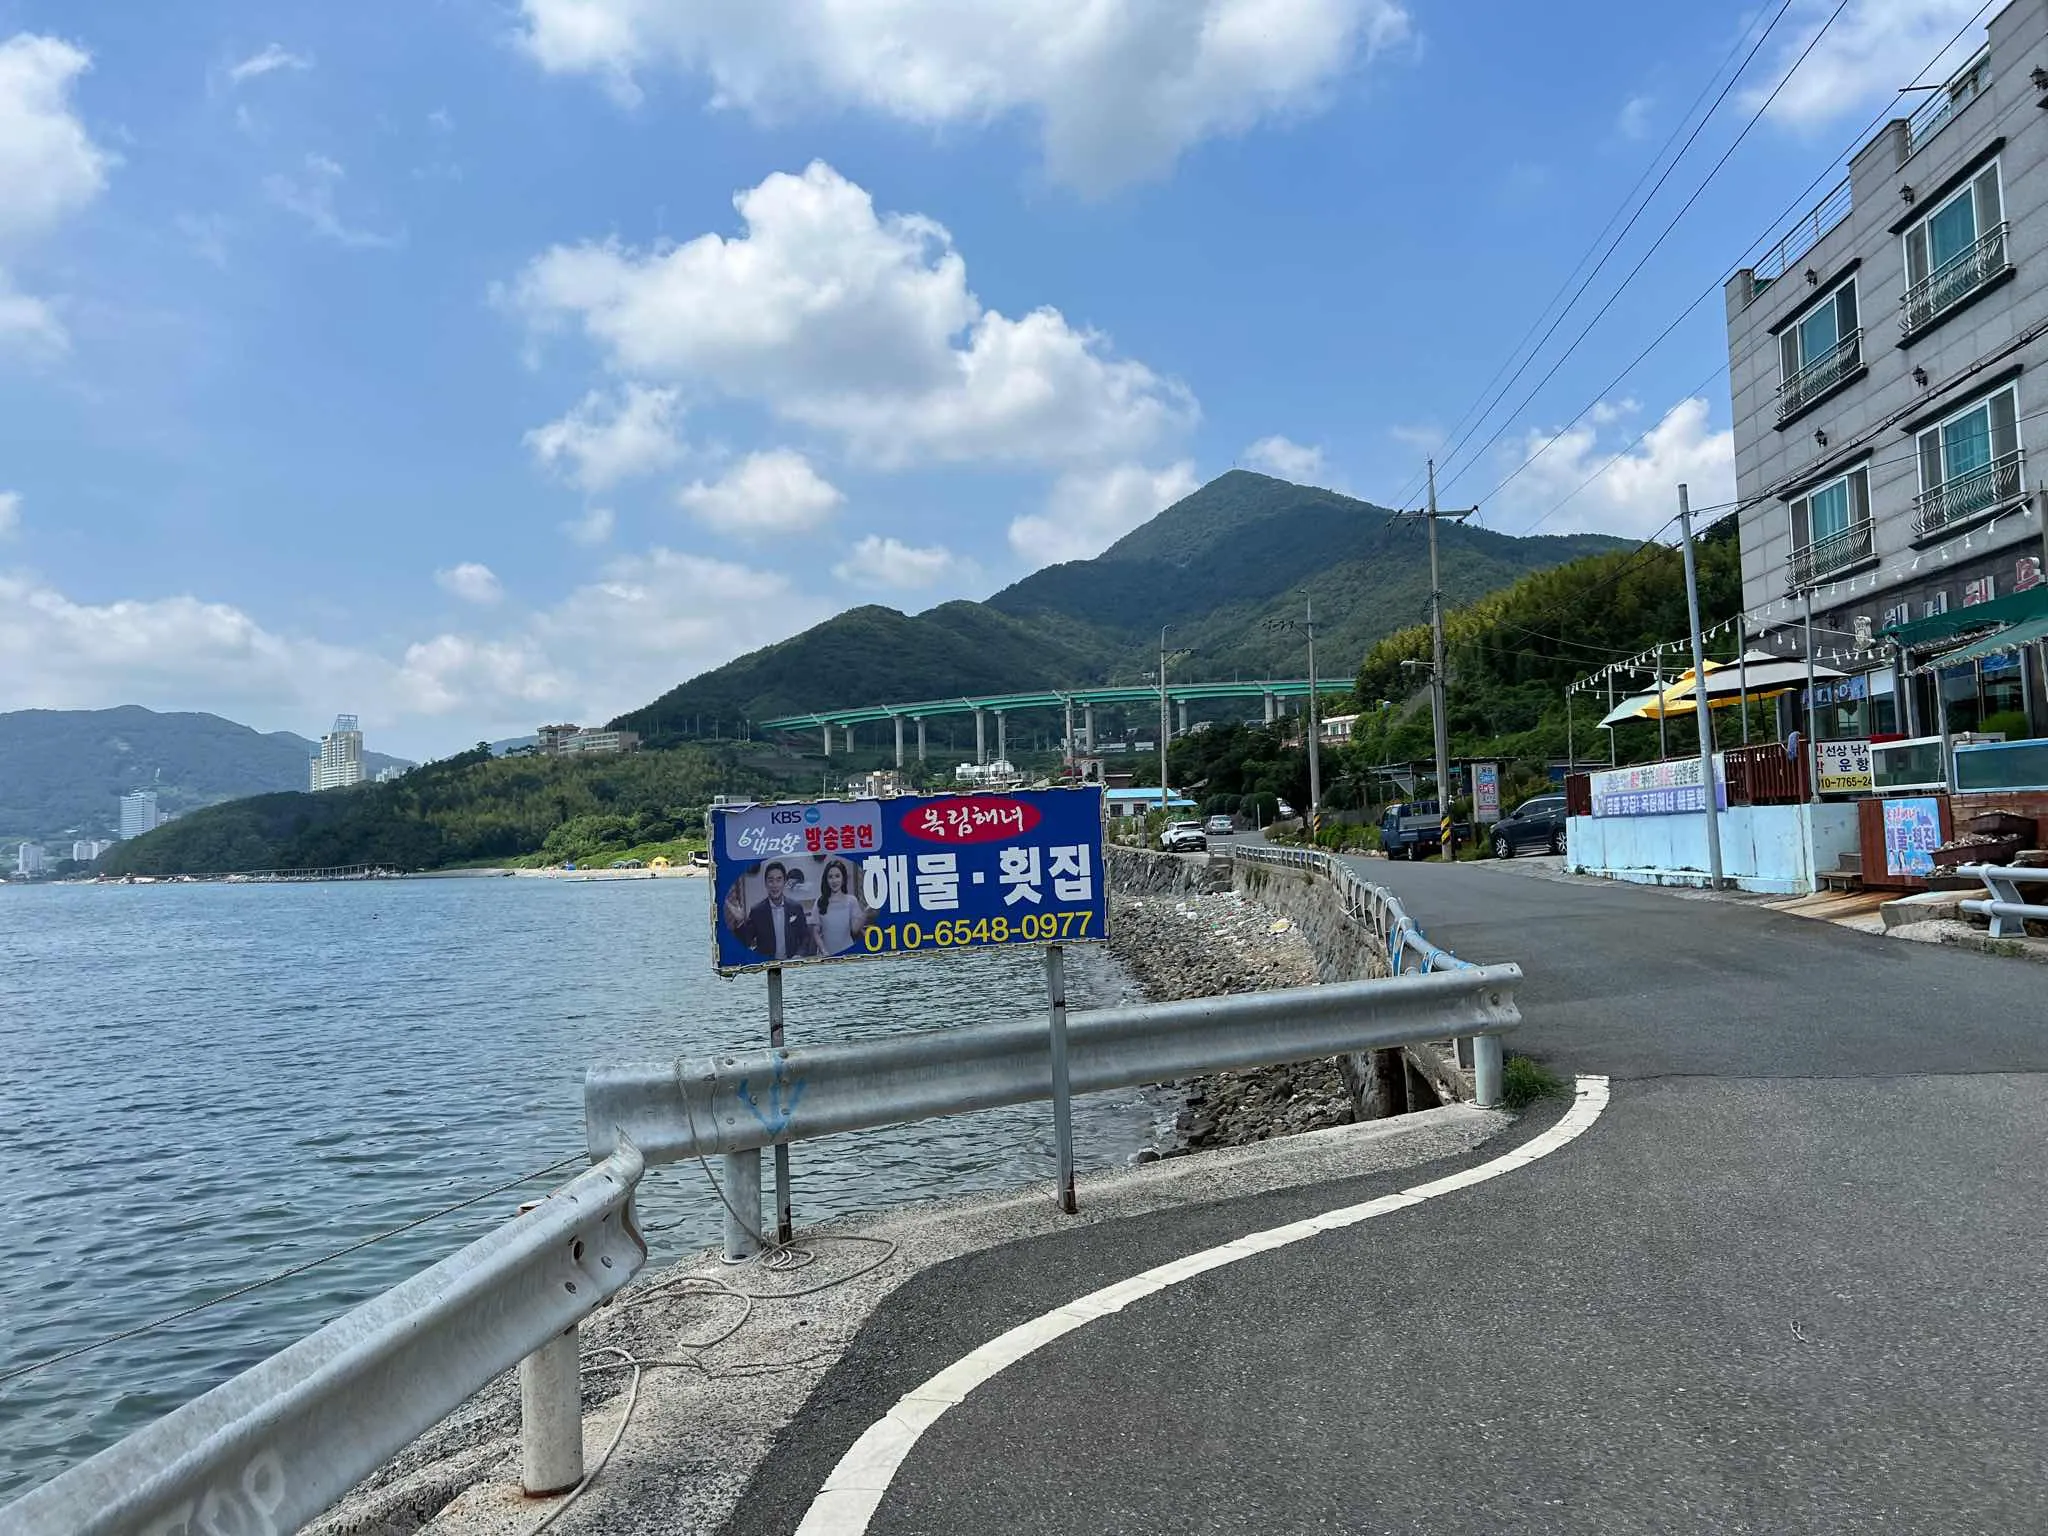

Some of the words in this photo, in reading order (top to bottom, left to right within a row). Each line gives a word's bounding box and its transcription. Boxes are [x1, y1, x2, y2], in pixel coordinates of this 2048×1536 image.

[1826, 745, 1847, 757] 선상
[771, 811, 802, 825] KBS
[921, 806, 1023, 837] 옥림해녀
[738, 826, 766, 848] 6시
[752, 833, 801, 855] 내고향
[804, 823, 873, 852] 방송출연
[864, 911, 1094, 952] 010-6548-0977
